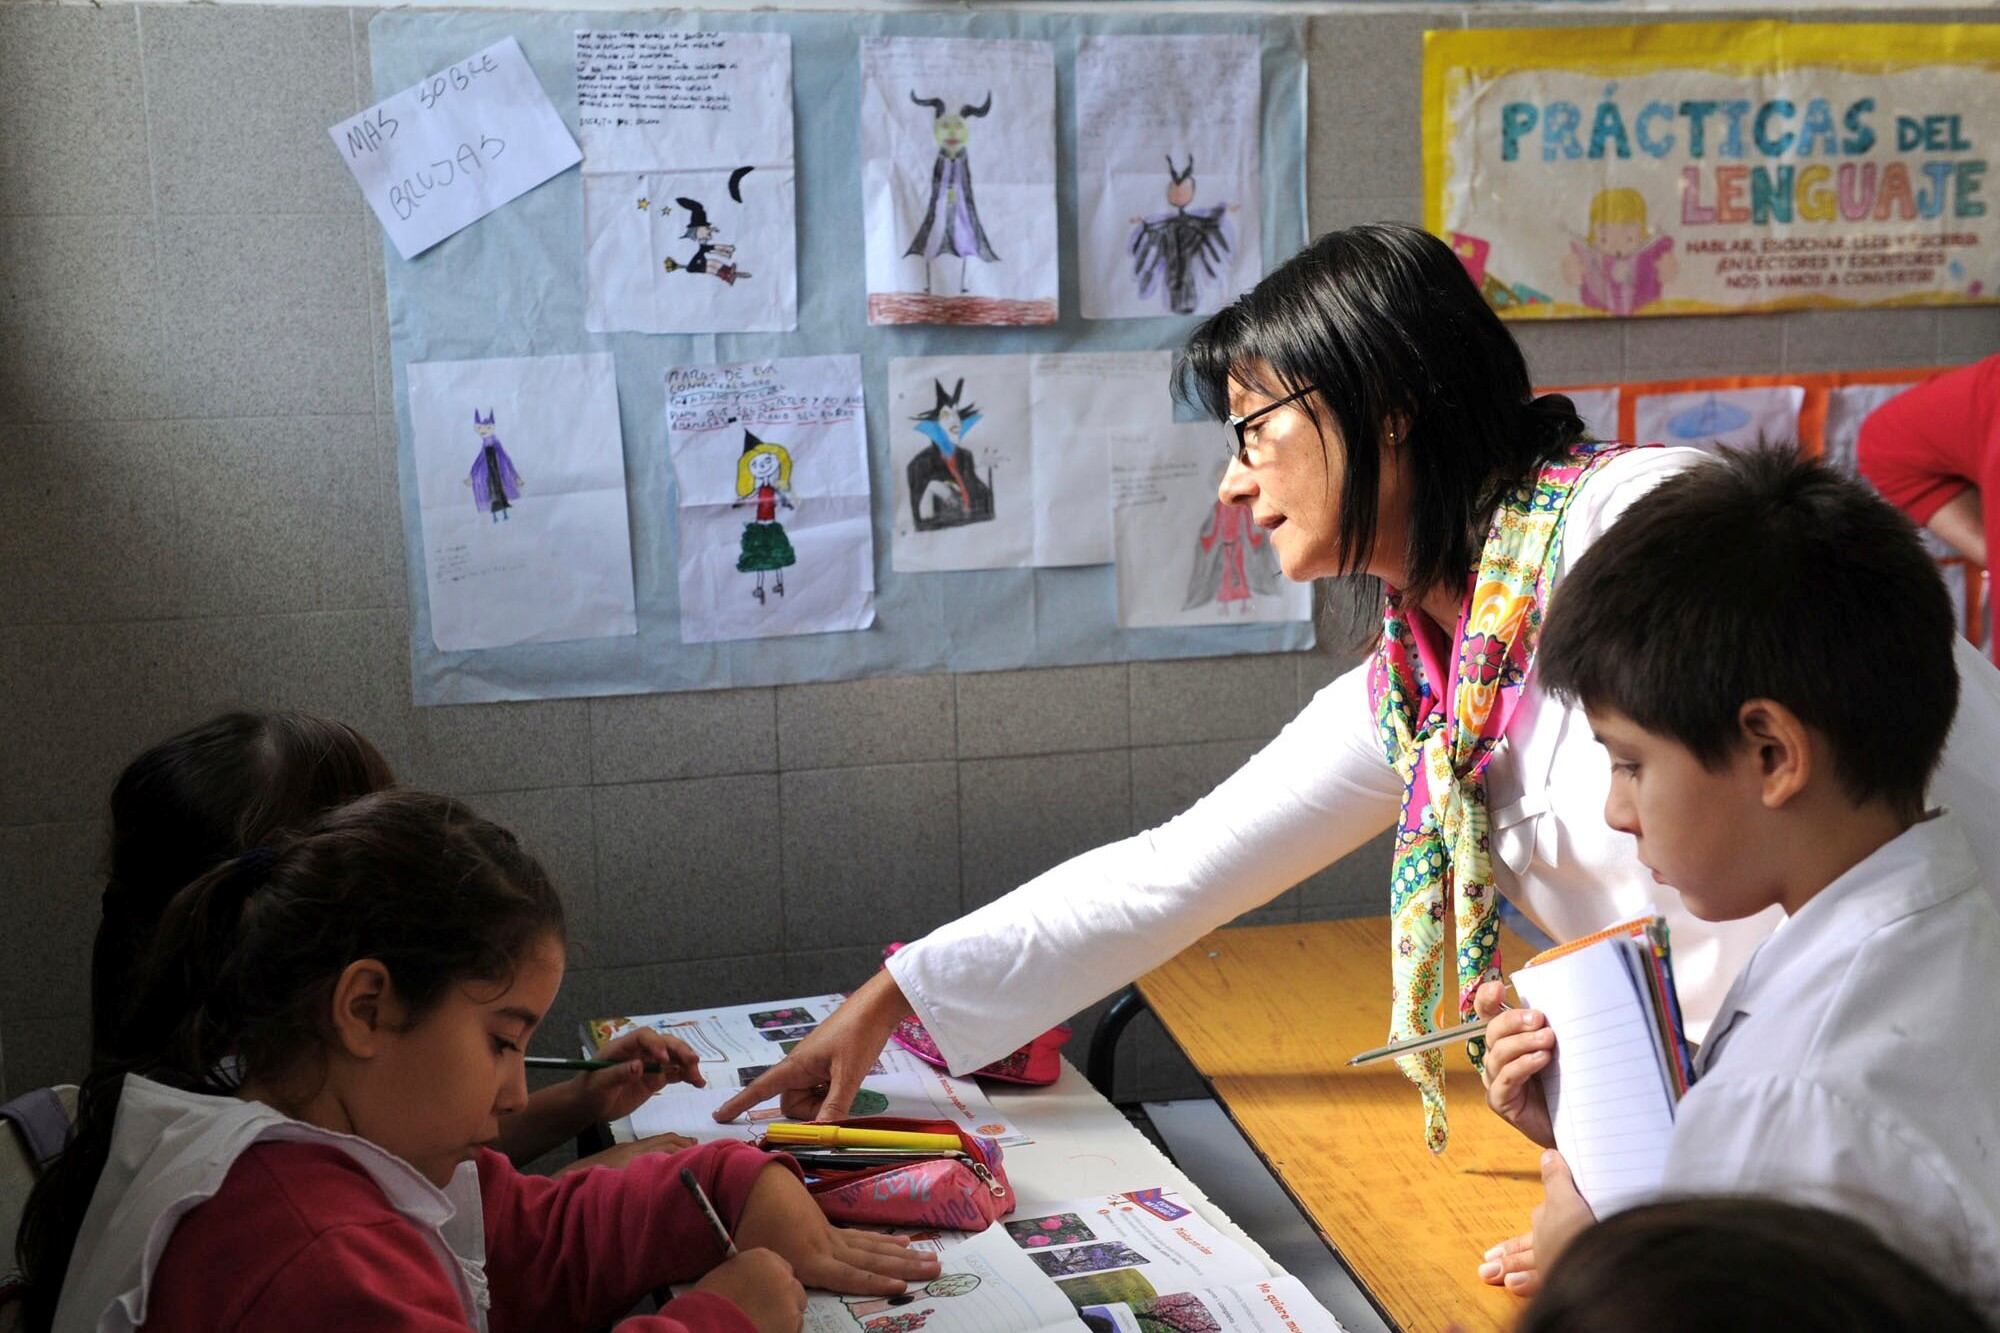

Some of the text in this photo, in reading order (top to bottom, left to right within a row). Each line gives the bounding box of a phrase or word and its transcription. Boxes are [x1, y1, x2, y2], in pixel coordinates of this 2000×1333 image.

[420, 54, 498, 110] SOBRE
[1500, 82, 1972, 162] PRÁCTICAS DEL
[389, 133, 506, 221] BRUJAS
[1681, 160, 1988, 226] LENGUAJE
[1725, 273, 1760, 289] NOS
[1765, 271, 1823, 288] VAMOS
[1827, 271, 1839, 286] A
[1263, 1294, 1290, 1320] quiere
